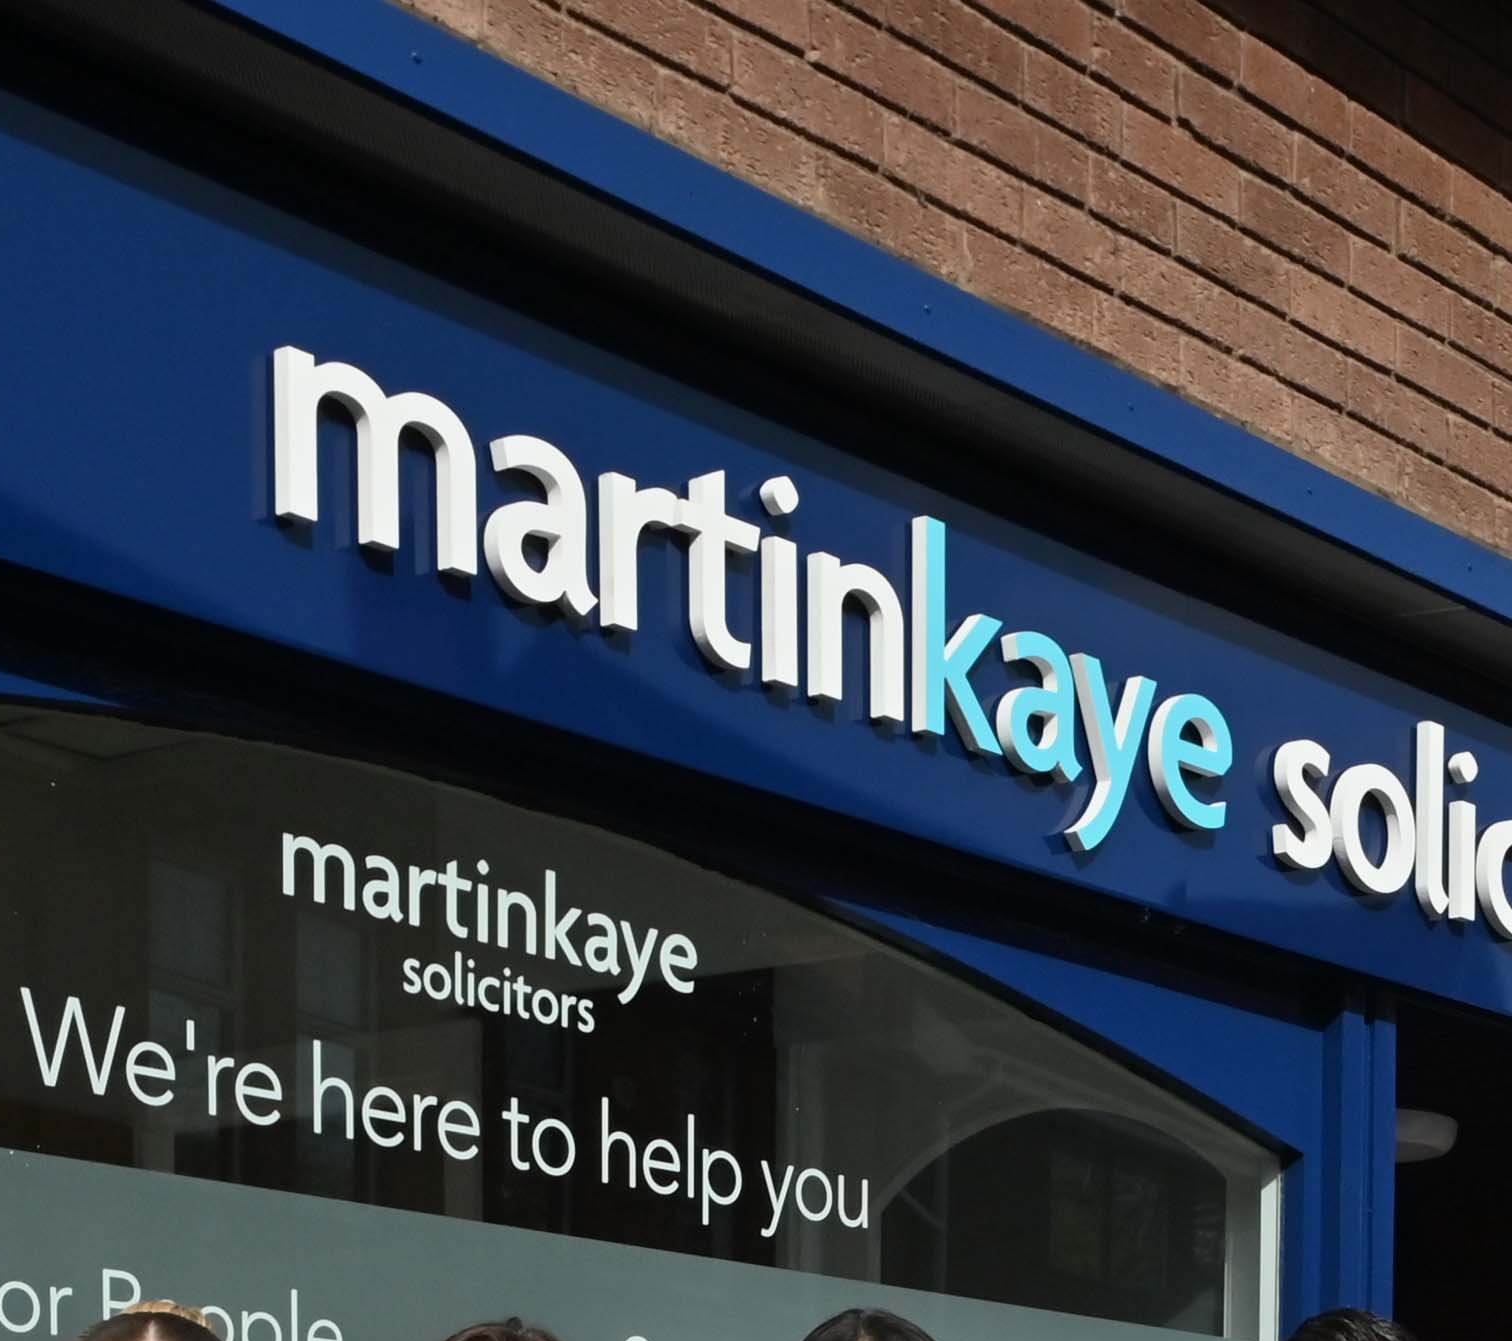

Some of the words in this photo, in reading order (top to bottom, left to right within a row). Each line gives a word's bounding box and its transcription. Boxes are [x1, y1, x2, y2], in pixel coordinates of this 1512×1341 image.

[272, 344, 1233, 854] martinkaye
[281, 831, 698, 1003] martinkaye
[401, 952, 596, 1034] solicitors
[20, 986, 283, 1126] We're
[311, 1040, 481, 1161] here
[501, 1096, 576, 1177] to
[600, 1096, 744, 1226] help
[759, 1156, 870, 1238] you
